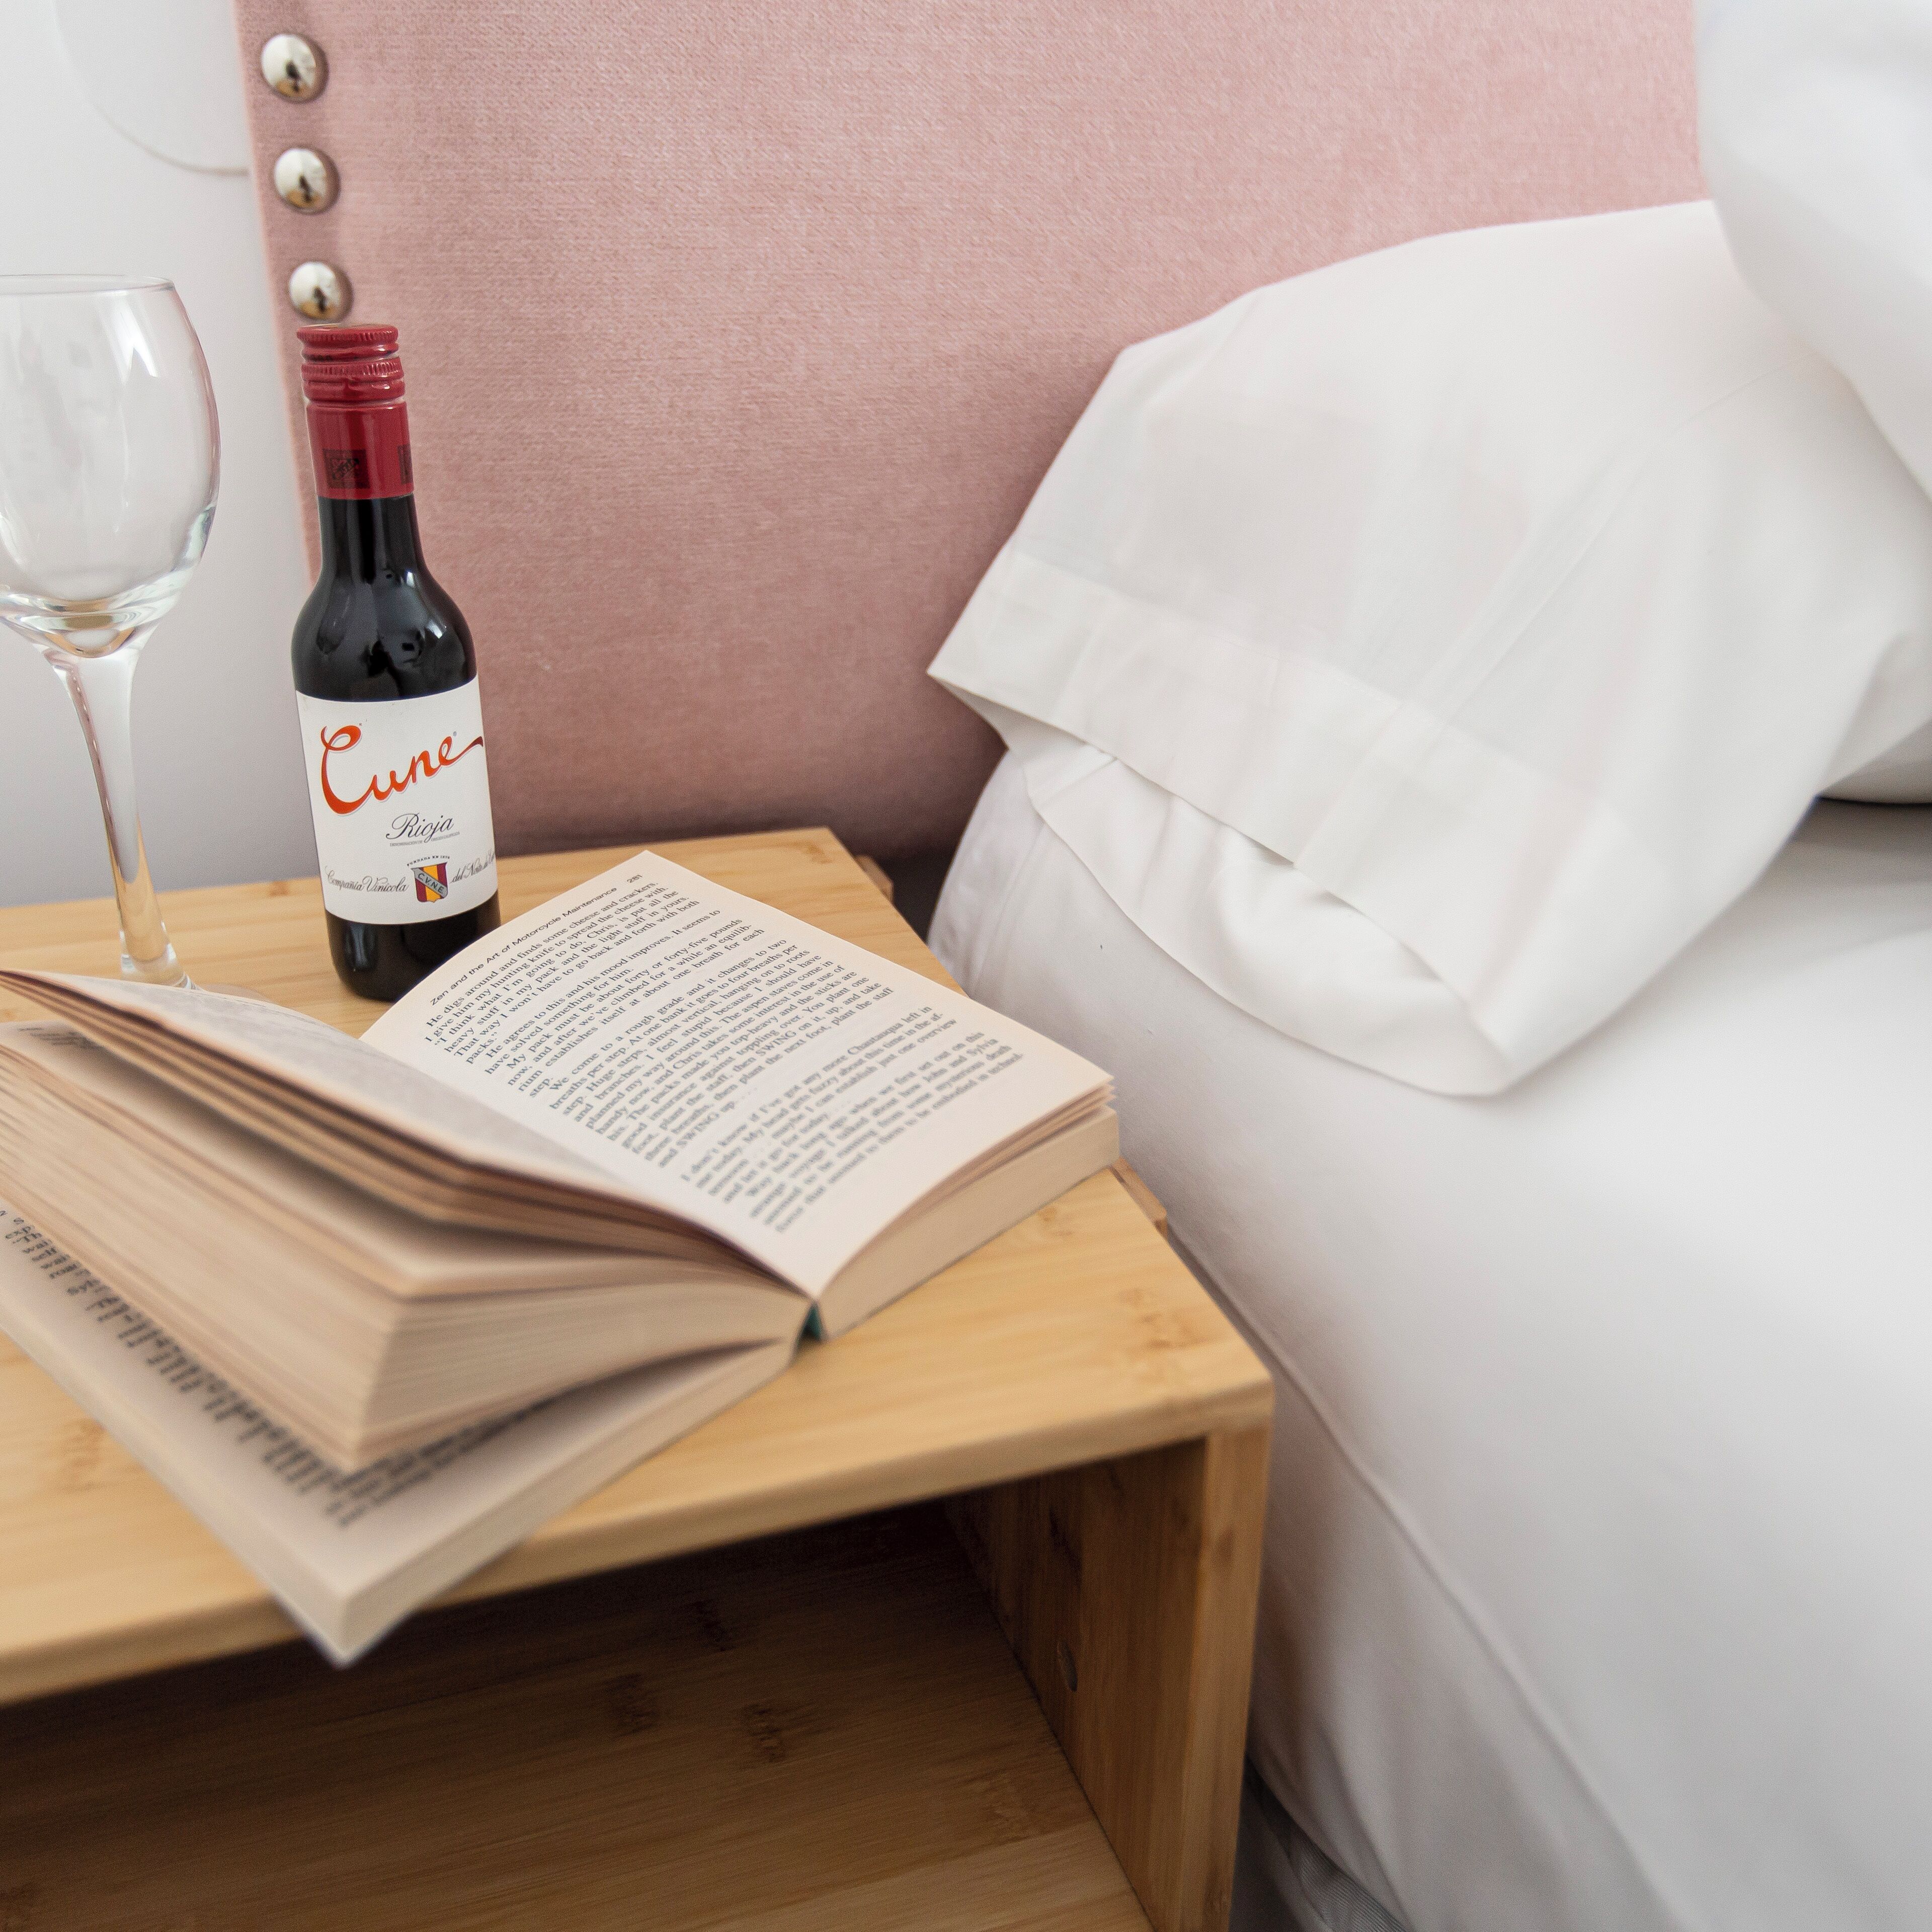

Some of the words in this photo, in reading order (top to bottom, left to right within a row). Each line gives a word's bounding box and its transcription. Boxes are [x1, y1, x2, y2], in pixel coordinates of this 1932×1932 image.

[320, 724, 484, 815] Cune
[385, 812, 454, 843] Rioja
[426, 1014, 443, 1027] He
[444, 997, 465, 1013] digs
[465, 971, 499, 997] around
[499, 958, 518, 972] and
[517, 943, 543, 958] finds
[542, 928, 569, 943] some
[569, 911, 600, 929] cheese
[600, 901, 619, 912] and
[618, 882, 659, 903] crackers.
[430, 990, 449, 1006] Zen
[450, 975, 468, 990] and
[468, 963, 484, 975] the
[487, 952, 501, 964] Art
[501, 944, 511, 953] of
[511, 917, 561, 946] Motorcycle
[561, 888, 617, 917] Maintenance
[626, 874, 643, 883] 281
[433, 1018, 454, 1037] give
[452, 1002, 475, 1018] him
[474, 989, 491, 1001] my
[490, 962, 531, 988] hunting
[527, 947, 555, 963] knife
[567, 922, 598, 940] spread
[597, 914, 614, 923] the
[614, 898, 645, 915] cheese
[644, 888, 669, 898] with.
[444, 1027, 474, 1053] heavy
[477, 1006, 500, 1025] stuff
[515, 984, 532, 996] my
[535, 967, 559, 983] pack
[561, 953, 580, 965] and
[581, 943, 598, 953] the
[598, 930, 623, 943] light
[624, 916, 647, 930] stuff
[660, 897, 689, 912] yours.
[449, 1014, 475, 1035] think
[477, 993, 503, 1011] what
[526, 958, 555, 978] going
[570, 941, 587, 949] do,
[587, 924, 618, 938] Chris,
[630, 907, 648, 917] put
[648, 899, 662, 907] all
[662, 891, 679, 900] the
[453, 1037, 479, 1056] That
[479, 1019, 501, 1035] way
[536, 976, 562, 992] have
[575, 959, 589, 970] go
[587, 946, 614, 959] back
[613, 934, 632, 946] and
[631, 923, 657, 936] forth
[656, 912, 679, 922] with
[676, 901, 700, 912] both
[485, 1045, 503, 1058] He
[503, 1020, 535, 1044] agrees
[534, 1011, 546, 1019] to
[545, 998, 566, 1011] this
[566, 985, 585, 998] and
[582, 976, 601, 986] his
[600, 958, 629, 976] mood
[625, 936, 674, 960] improves.
[682, 915, 711, 931] seems
[728, 971, 750, 983] four
[747, 953, 783, 972] breaths
[782, 944, 798, 955] per
[760, 970, 775, 978] on
[785, 950, 810, 963] roots
[765, 968, 797, 986] should
[796, 955, 822, 968] have
[797, 967, 823, 981] come
[814, 980, 842, 995] sticks
[841, 972, 857, 981] are
[816, 973, 834, 982] use
[833, 964, 845, 973] of
[826, 987, 851, 1003] plant
[851, 977, 869, 987] one
[484, 1054, 510, 1075] have
[510, 1026, 543, 1053] solved
[543, 991, 596, 1026] something
[593, 981, 610, 991] for
[608, 969, 634, 981] him.
[506, 1054, 526, 1069] My
[528, 1033, 553, 1053] pack
[554, 1013, 581, 1031] must
[578, 1003, 595, 1012] be
[596, 984, 625, 1003] about
[624, 969, 650, 984] forty
[664, 937, 708, 961] forty-five
[709, 919, 743, 938] pounds
[518, 1070, 543, 1092] rium
[545, 1026, 598, 1067] establishes
[599, 1006, 626, 1025] itself
[642, 981, 671, 998] about
[673, 969, 691, 980] one
[691, 951, 724, 968] breath
[723, 941, 740, 951] for
[743, 929, 765, 941] each
[533, 1046, 553, 1063] and
[553, 1027, 577, 1045] after
[610, 980, 650, 1005] climbed
[650, 971, 666, 981] for
[676, 951, 703, 965] while
[549, 1077, 570, 1090] We
[572, 1053, 599, 1075] come
[600, 1043, 613, 1051] to
[624, 1015, 656, 1035] rough
[657, 997, 685, 1015] grade
[686, 983, 706, 996] and
[717, 957, 755, 978] changes
[767, 940, 787, 950] two
[842, 993, 861, 1005] and
[860, 983, 882, 995] take
[855, 1001, 872, 1010] the
[872, 987, 894, 1001] staff
